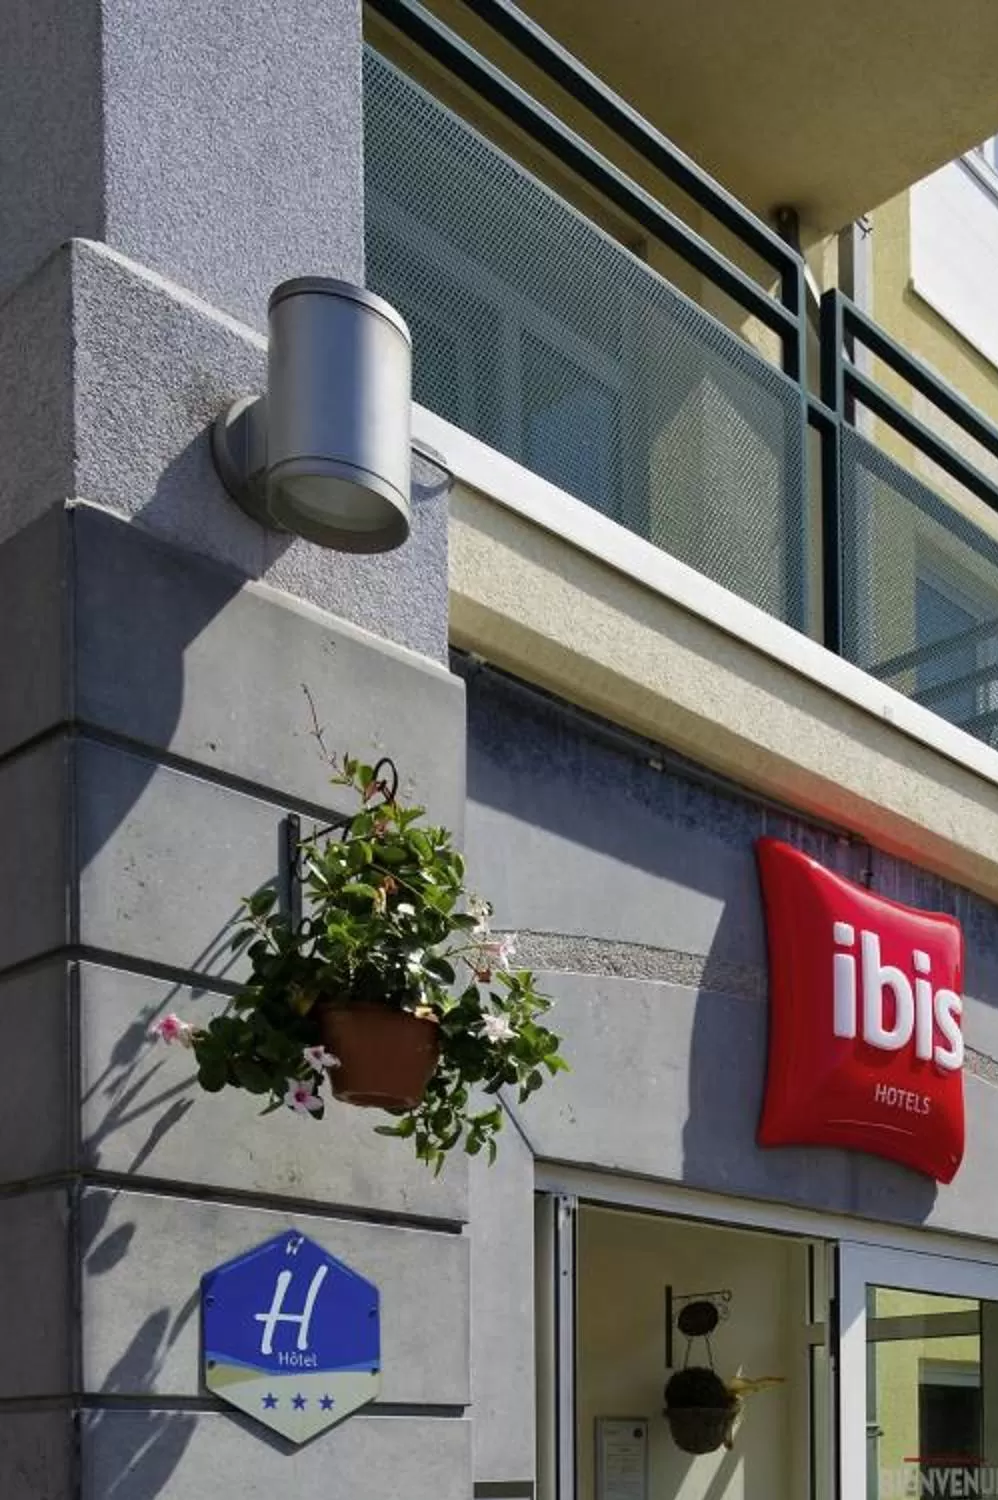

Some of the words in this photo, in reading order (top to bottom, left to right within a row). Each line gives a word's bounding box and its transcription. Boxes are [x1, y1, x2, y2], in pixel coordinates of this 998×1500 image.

[833, 921, 964, 1072] ibis
[875, 1083, 930, 1115] HOTELS
[254, 1264, 328, 1354] H
[277, 1351, 318, 1367] Hôtel
